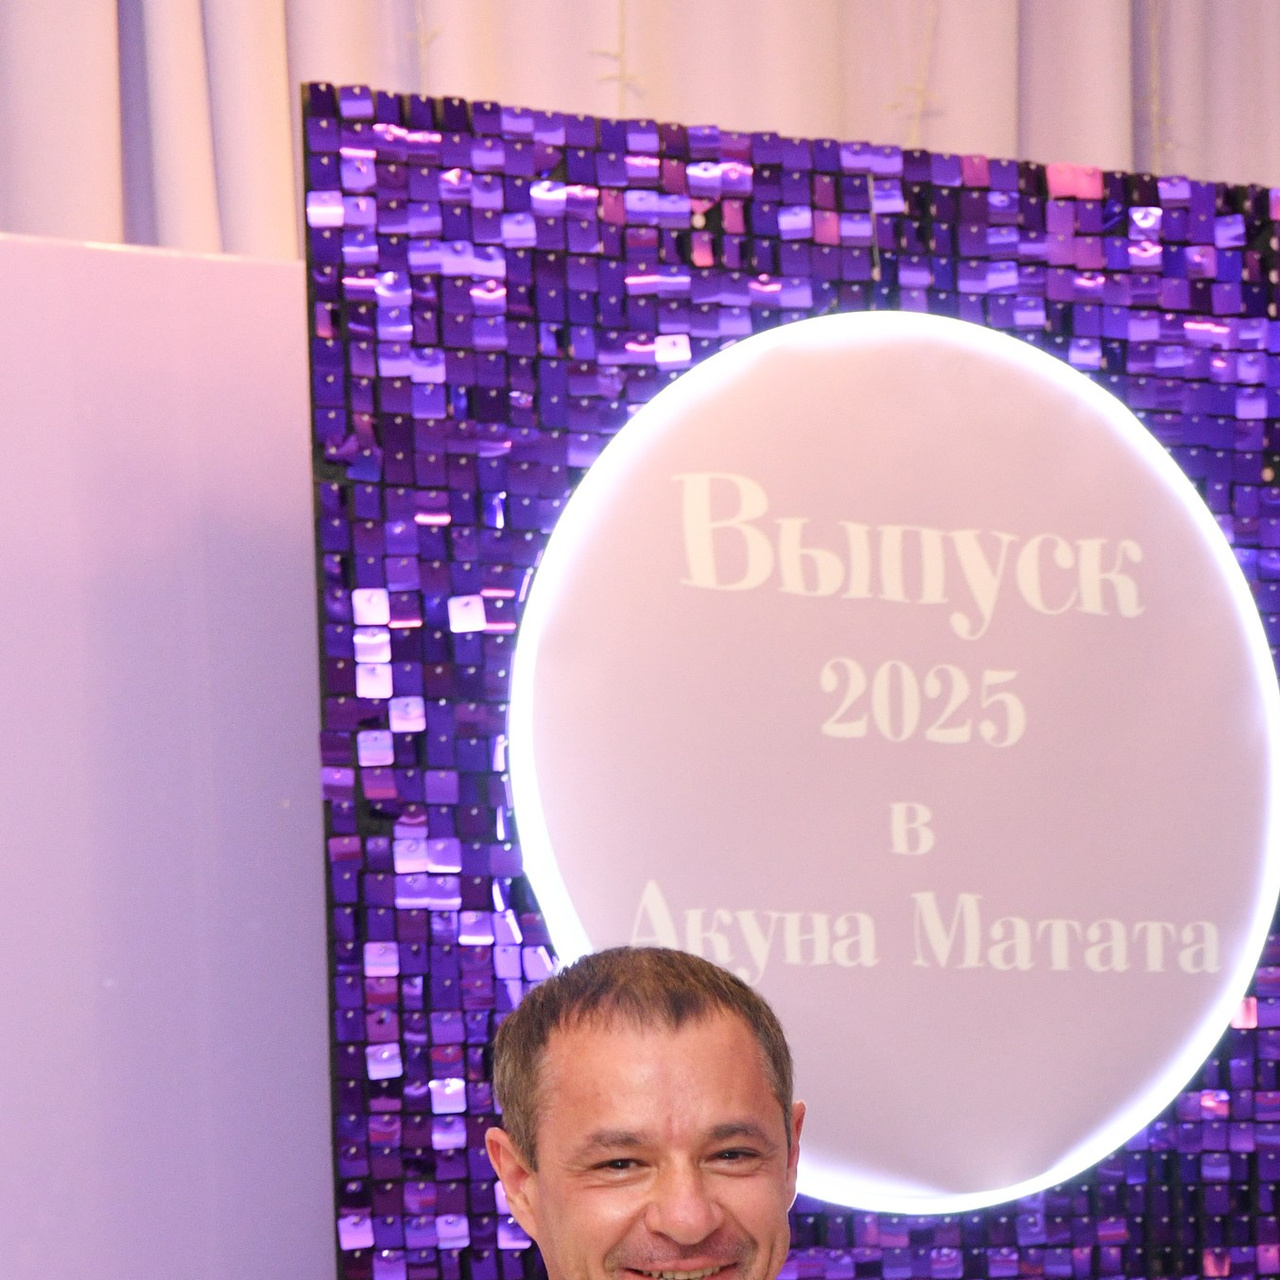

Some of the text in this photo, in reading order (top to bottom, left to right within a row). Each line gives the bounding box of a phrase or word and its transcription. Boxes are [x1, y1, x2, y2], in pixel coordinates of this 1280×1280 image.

[671, 470, 1145, 640] Выпуск
[819, 656, 1027, 748] 2025
[628, 879, 1222, 984] Акуна Матата
